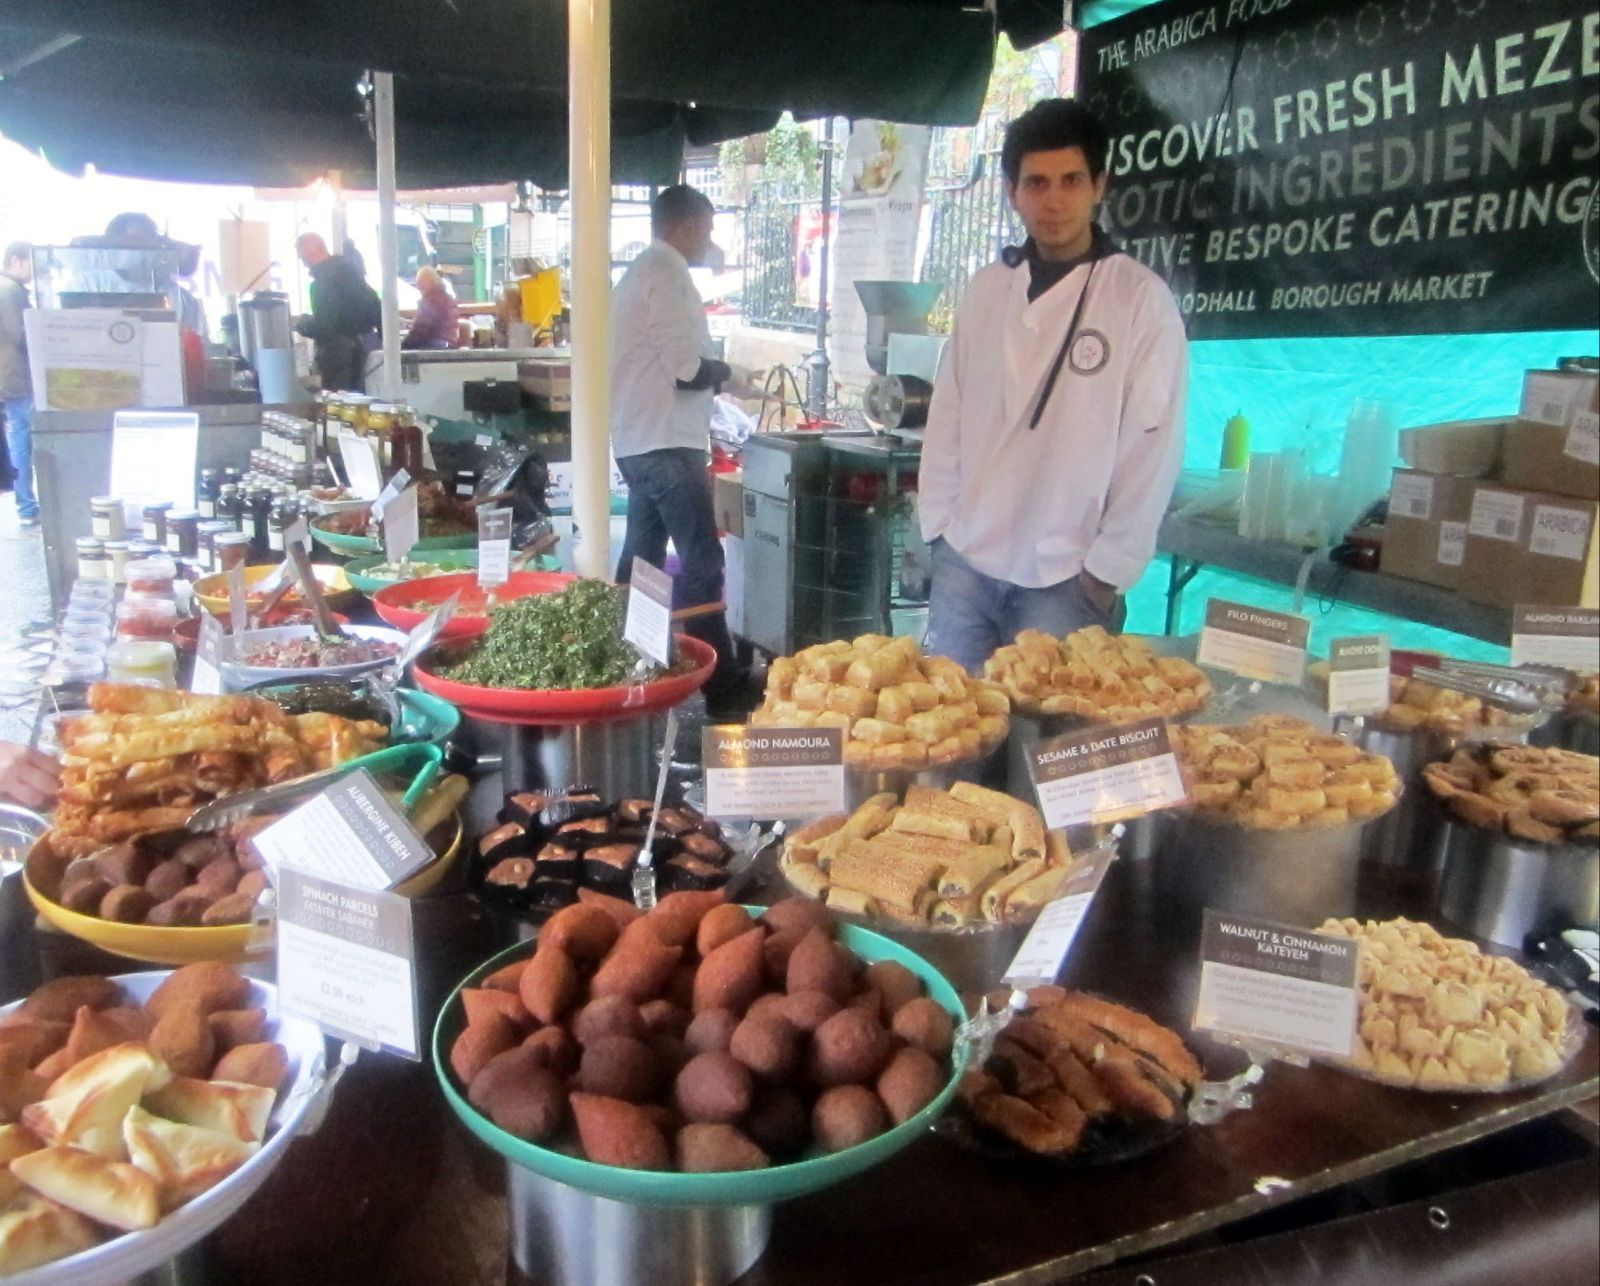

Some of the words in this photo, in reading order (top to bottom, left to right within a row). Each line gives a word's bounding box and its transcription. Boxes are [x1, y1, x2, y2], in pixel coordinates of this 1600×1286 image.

[1097, 40, 1129, 73] THE
[1134, 7, 1216, 61] ARABICA
[1104, 106, 1259, 176] ISCOVER
[1273, 62, 1416, 145] FRESH
[1440, 11, 1599, 108] MEZE
[1231, 94, 1599, 214] INGREDIENTS
[1204, 212, 1355, 263] BESPOKE
[1368, 176, 1592, 247] CATERING
[1271, 281, 1382, 310] BOROUGH
[1386, 271, 1495, 304] MARKET
[1227, 609, 1248, 621] FILO
[1250, 613, 1288, 631] FINGERS
[718, 737, 769, 750] ALMOND
[772, 736, 831, 749] NAMOURA
[1037, 747, 1078, 766] SESAME
[1079, 744, 1088, 756] &
[1090, 738, 1117, 754] DATE
[1119, 726, 1159, 748] BISCUIT
[345, 785, 391, 835] AUBERGINE
[302, 884, 339, 906] SPINACH
[340, 896, 379, 918] PARCELS
[1219, 922, 1268, 942] WALNUT
[1270, 933, 1280, 944] &
[1282, 935, 1347, 957] CINNAMON
[1257, 942, 1310, 961] KATEYEH
